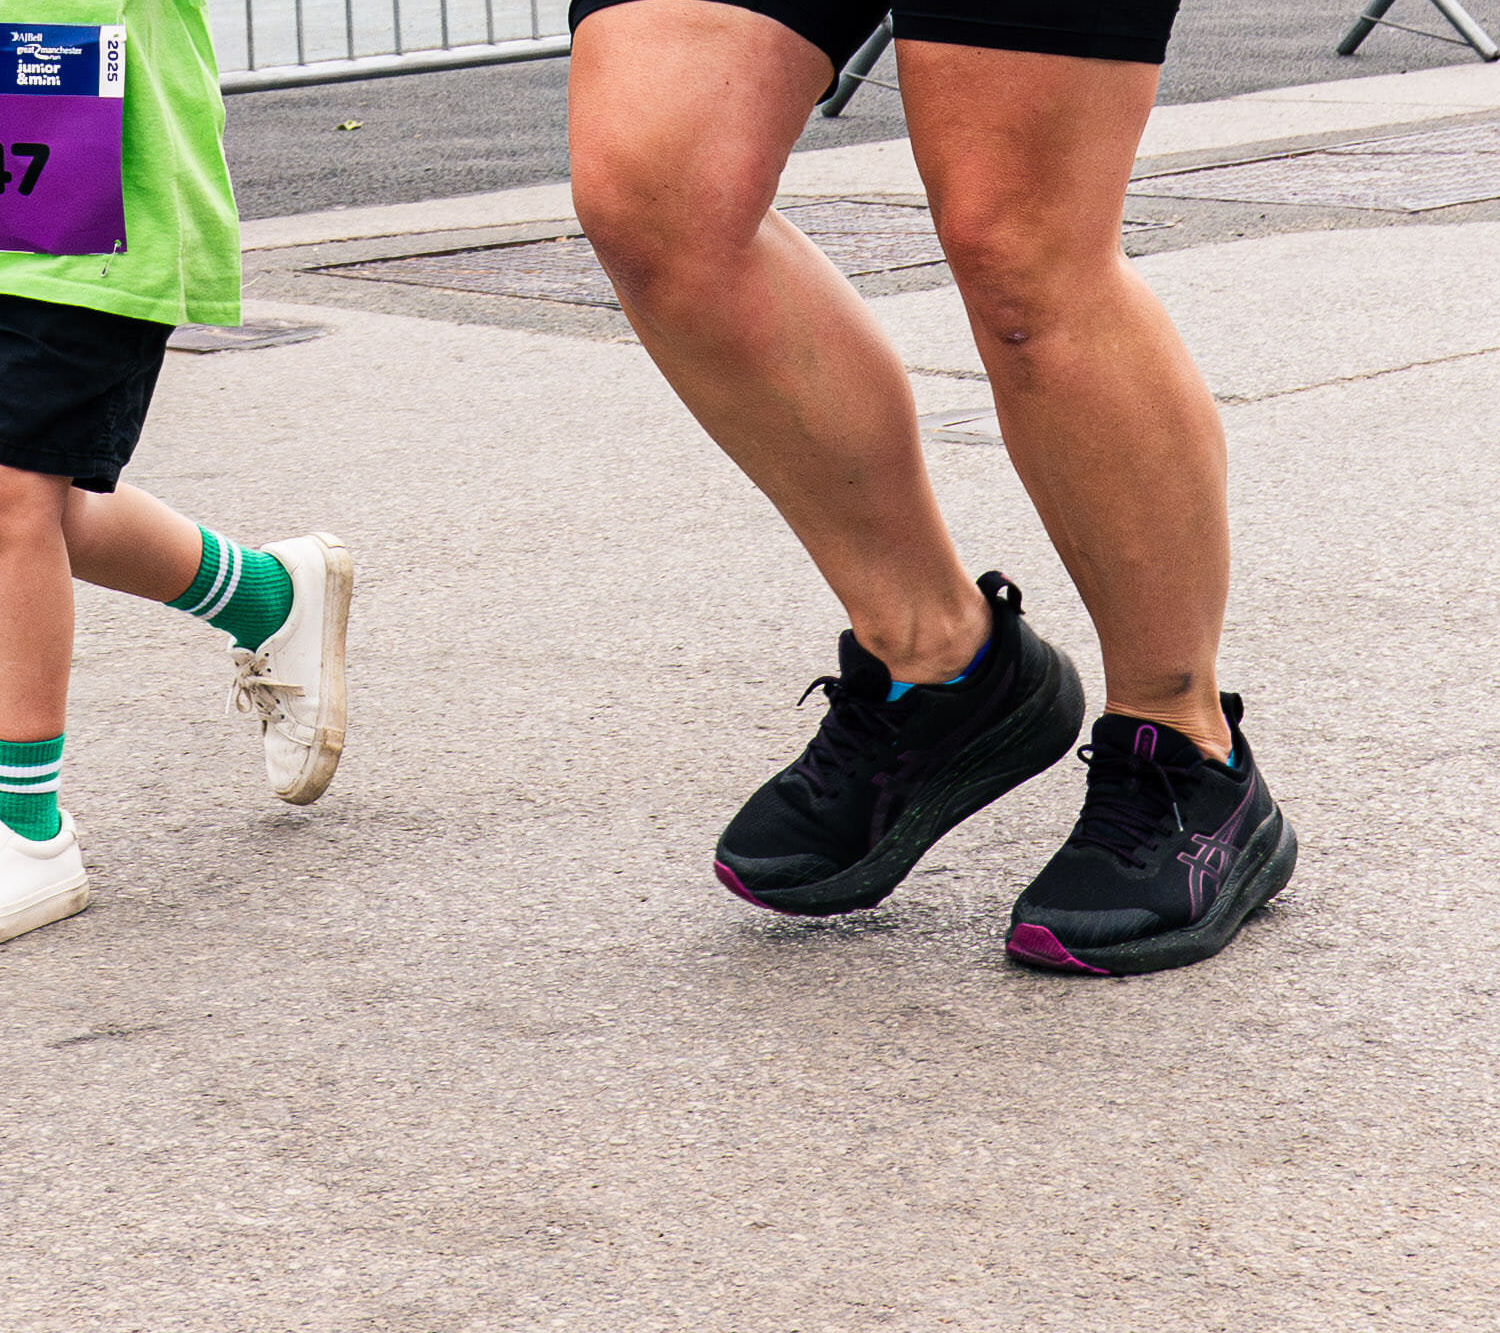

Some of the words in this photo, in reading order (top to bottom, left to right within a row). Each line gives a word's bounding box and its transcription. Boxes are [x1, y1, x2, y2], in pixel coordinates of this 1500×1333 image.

[16, 59, 62, 75] junior
[106, 39, 119, 83] 2025
[16, 73, 62, 87] &mini
